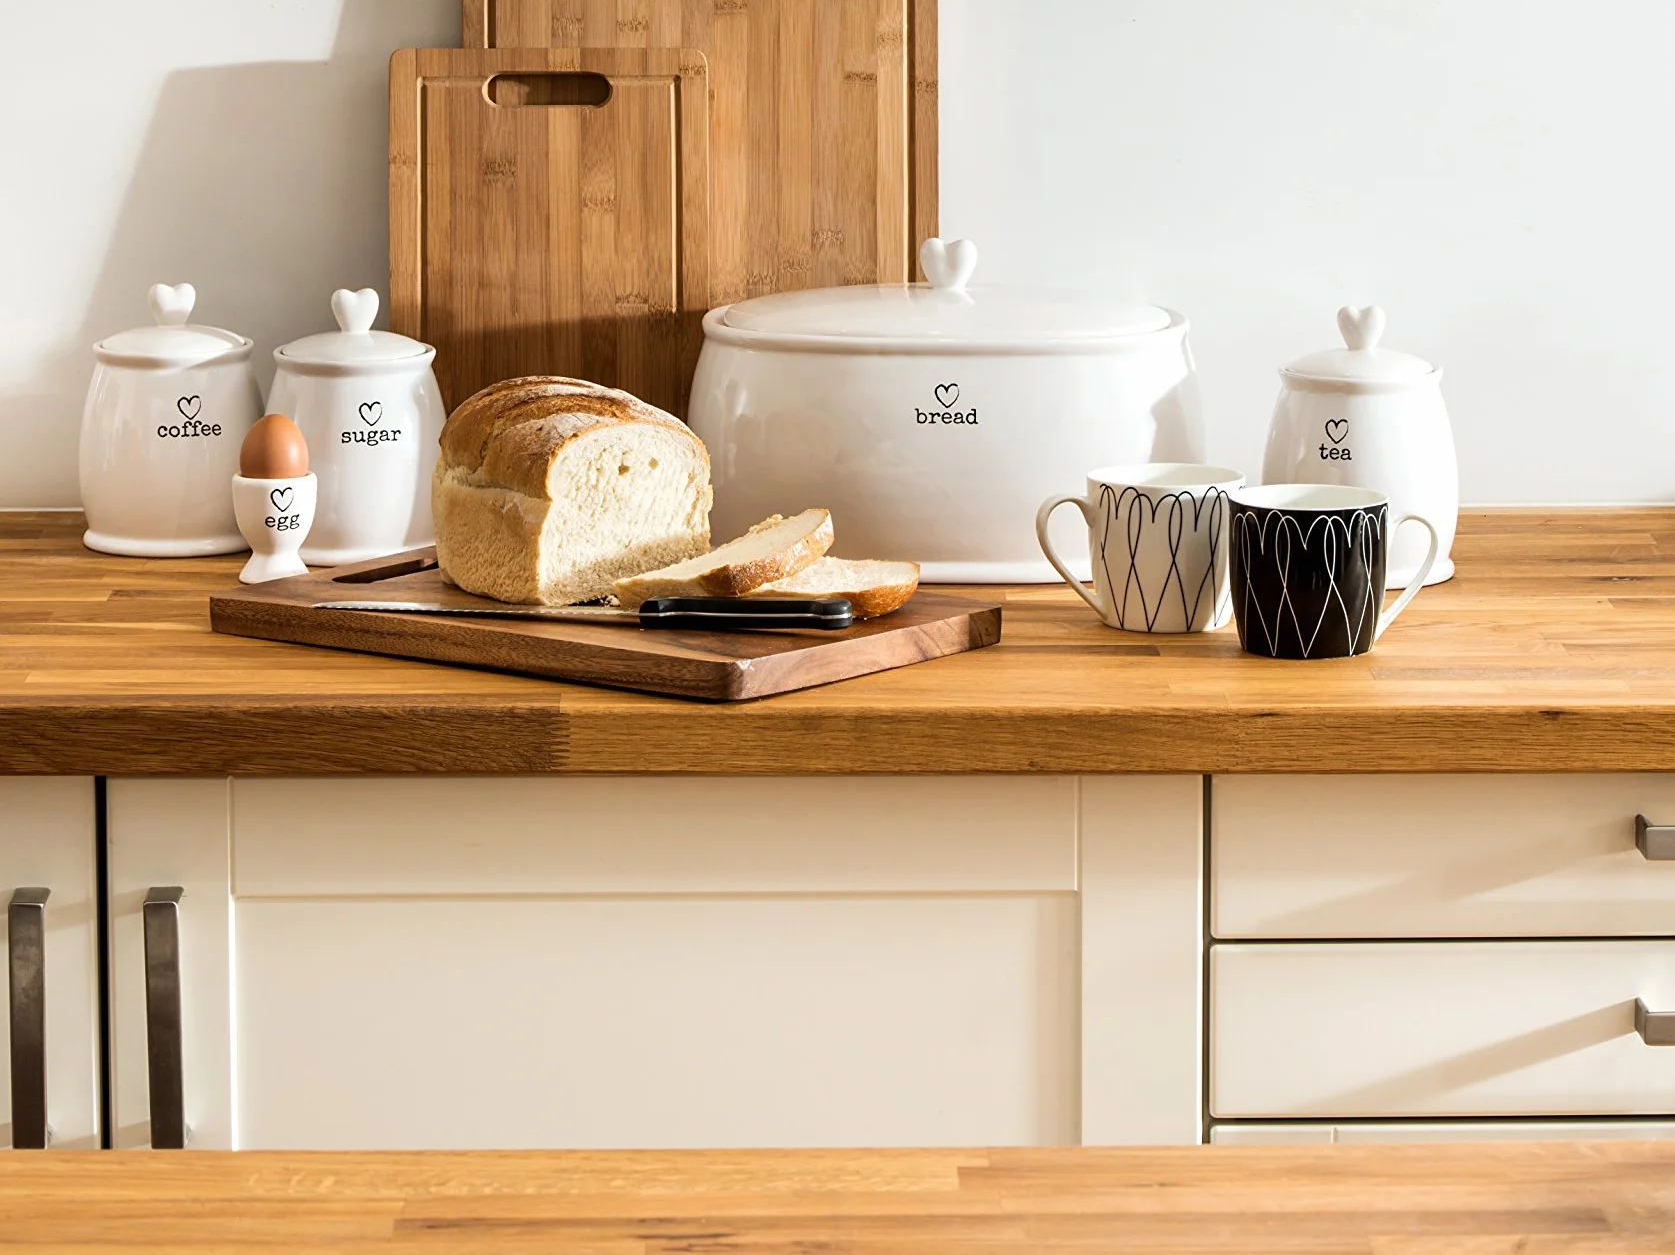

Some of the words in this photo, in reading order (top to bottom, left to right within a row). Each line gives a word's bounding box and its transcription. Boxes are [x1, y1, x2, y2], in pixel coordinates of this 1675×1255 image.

[914, 408, 979, 425] bread
[157, 421, 222, 438] coffee
[341, 428, 402, 447] sugar
[1319, 443, 1353, 461] tea
[264, 513, 300, 532] egg
